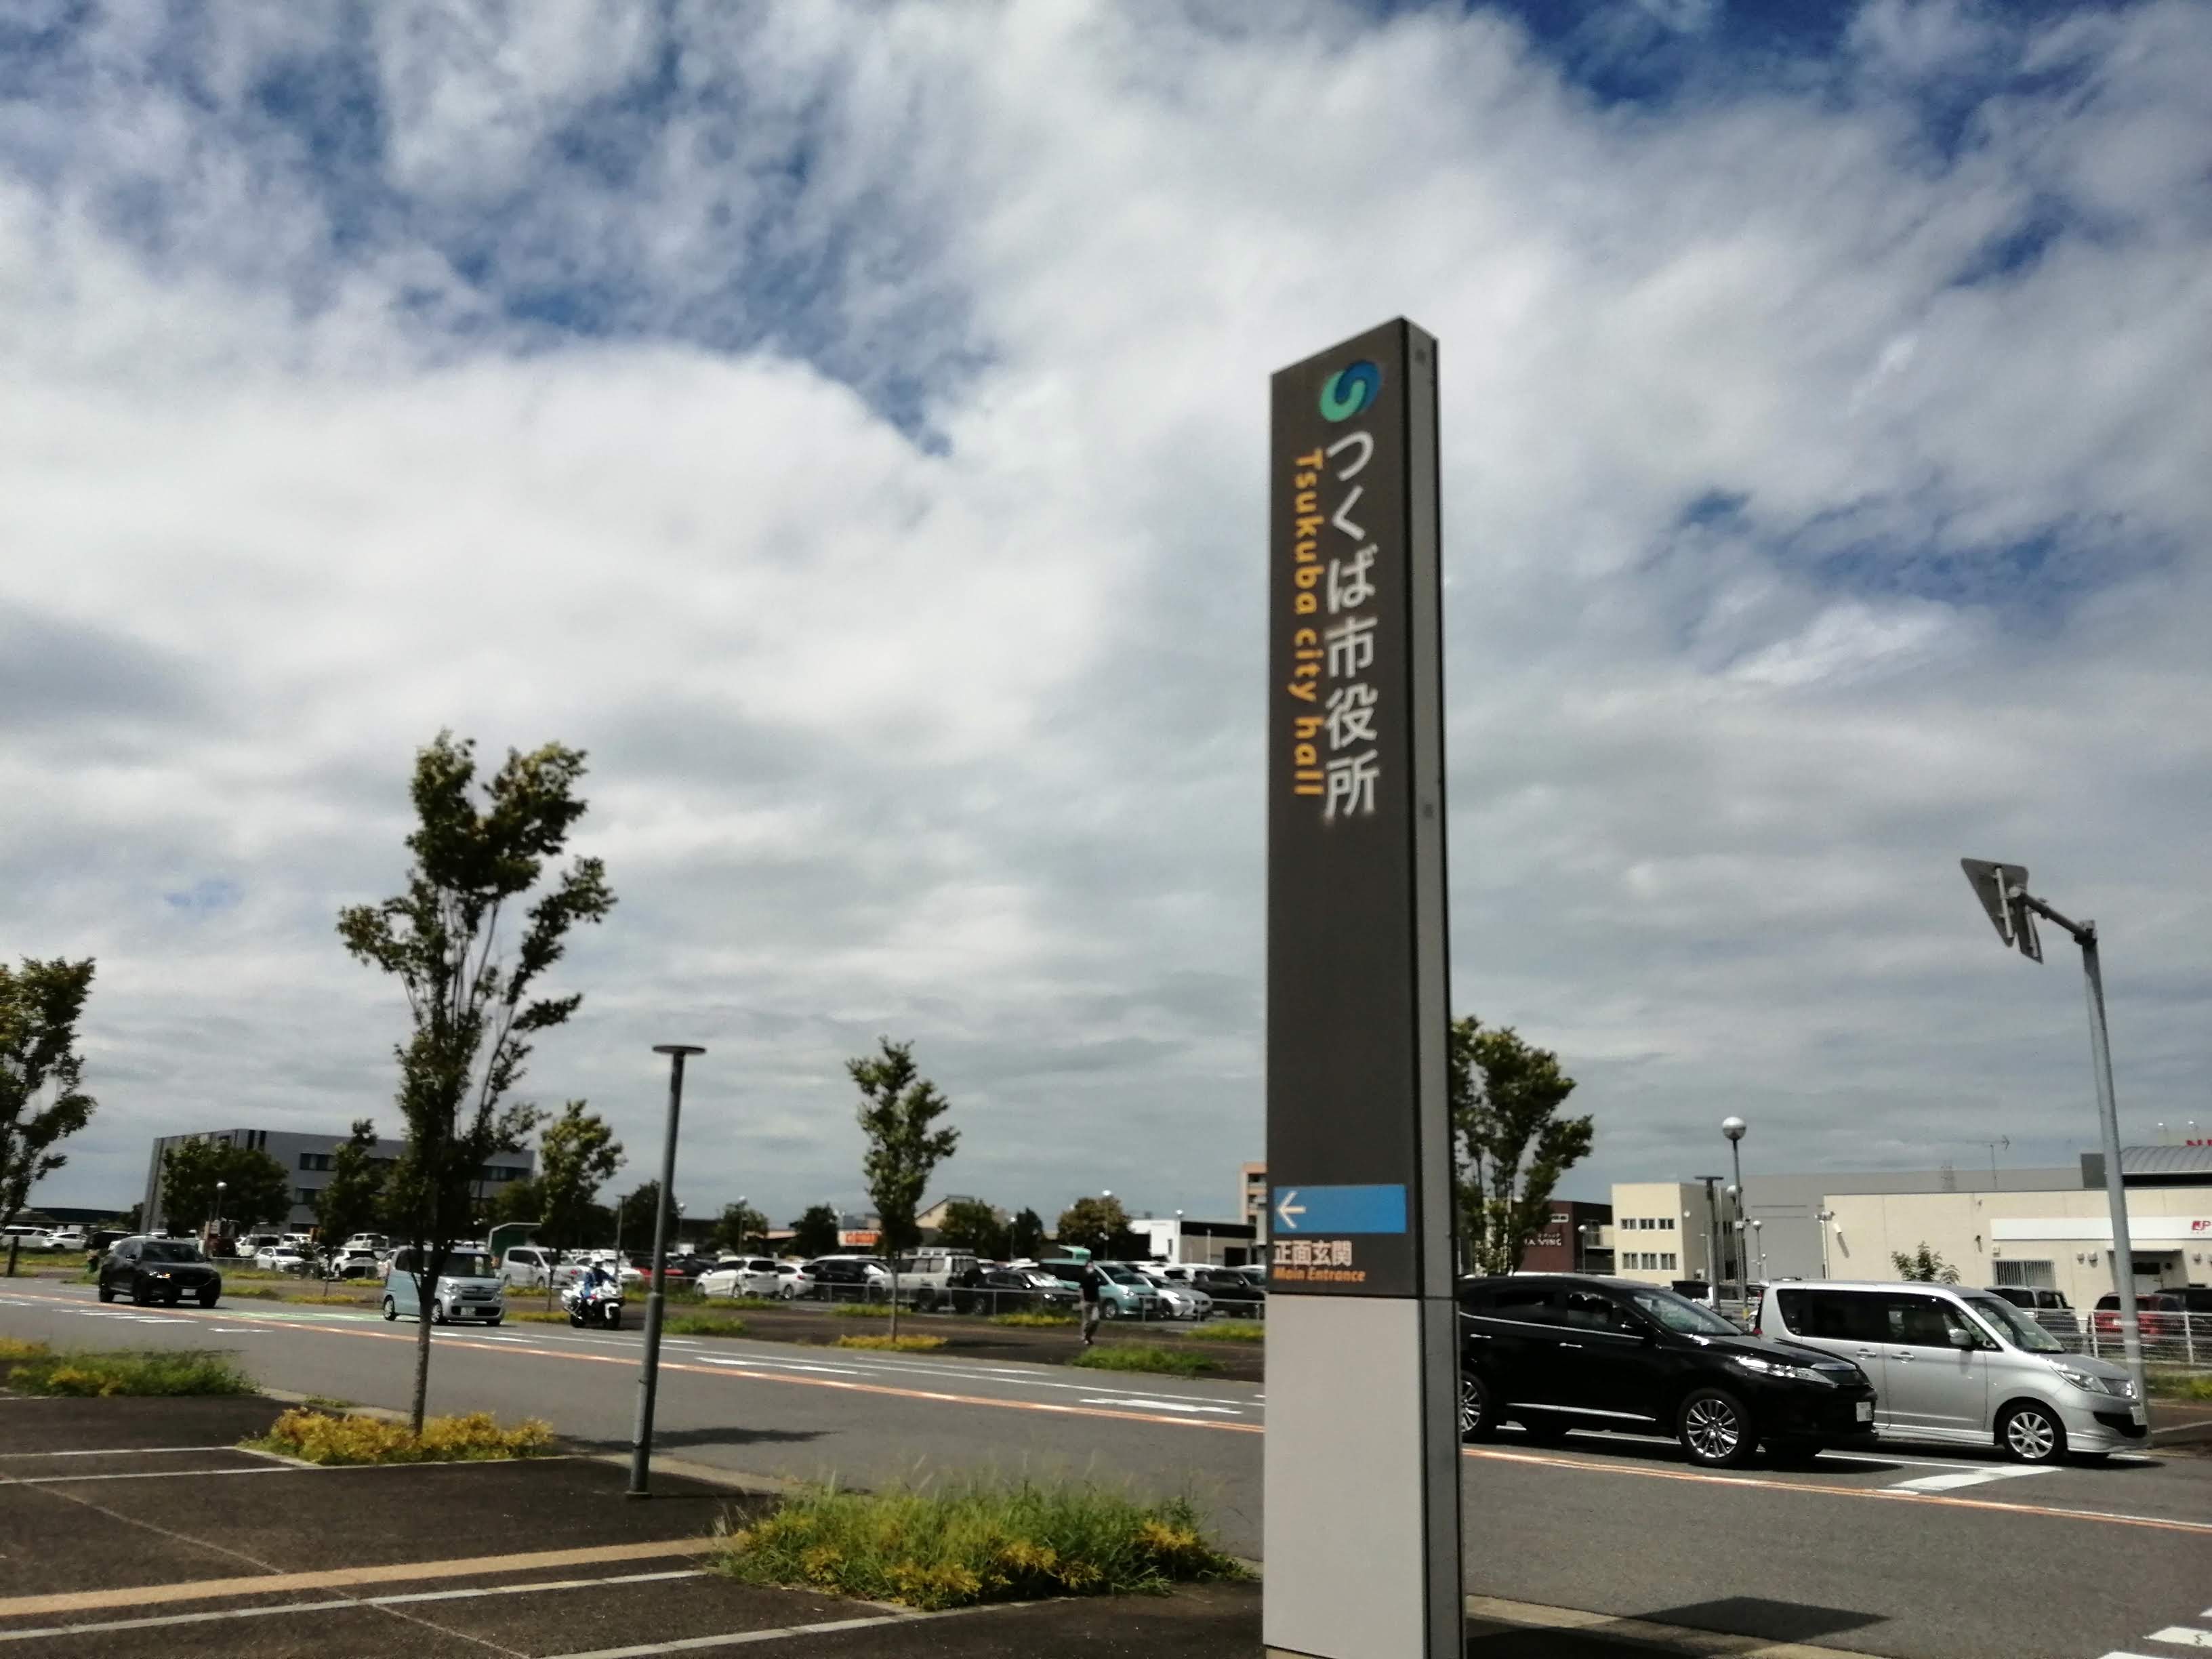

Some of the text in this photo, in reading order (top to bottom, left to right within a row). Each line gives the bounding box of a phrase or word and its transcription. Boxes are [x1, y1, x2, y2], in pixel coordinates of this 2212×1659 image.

[1288, 448, 1324, 796] Tsukuba city hall
[1324, 431, 1379, 821] つくば市役所
[1273, 1240, 1353, 1267] 正面玄関
